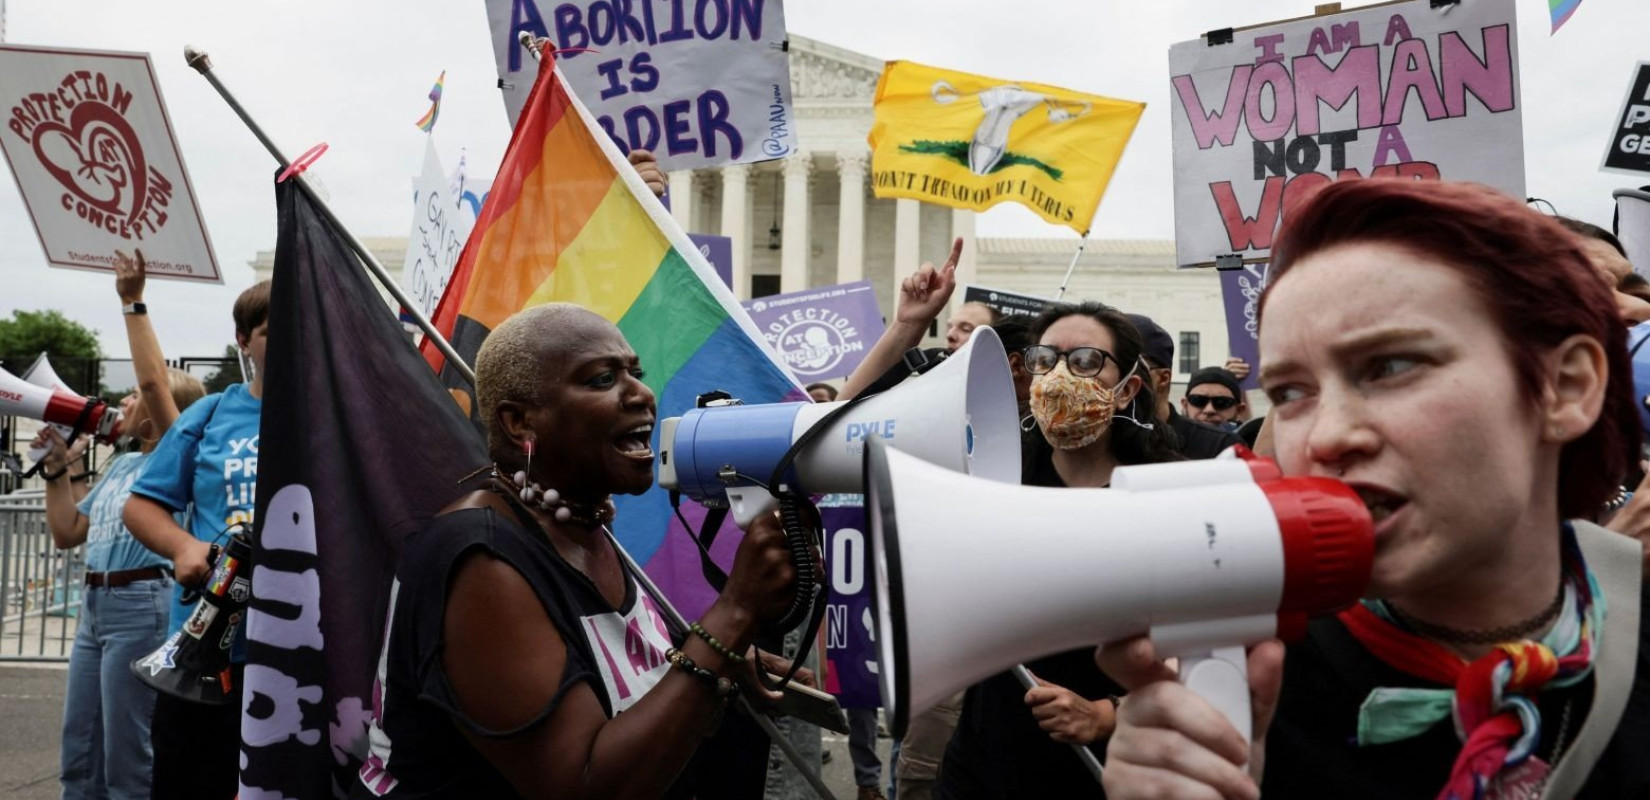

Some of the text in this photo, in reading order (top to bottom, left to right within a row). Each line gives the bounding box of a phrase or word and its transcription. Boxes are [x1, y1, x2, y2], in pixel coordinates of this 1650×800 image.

[507, 0, 766, 72] ABORTION
[1254, 14, 1413, 64] I AM A
[597, 52, 660, 101] IS
[1171, 24, 1515, 150] WOMAN
[9, 71, 133, 144] PROTECTION
[99, 138, 121, 163] AT
[1253, 124, 1413, 180] NOT A
[61, 165, 173, 241] CONCEPTION
[764, 308, 858, 343] ROTECTION
[785, 333, 804, 345] AT
